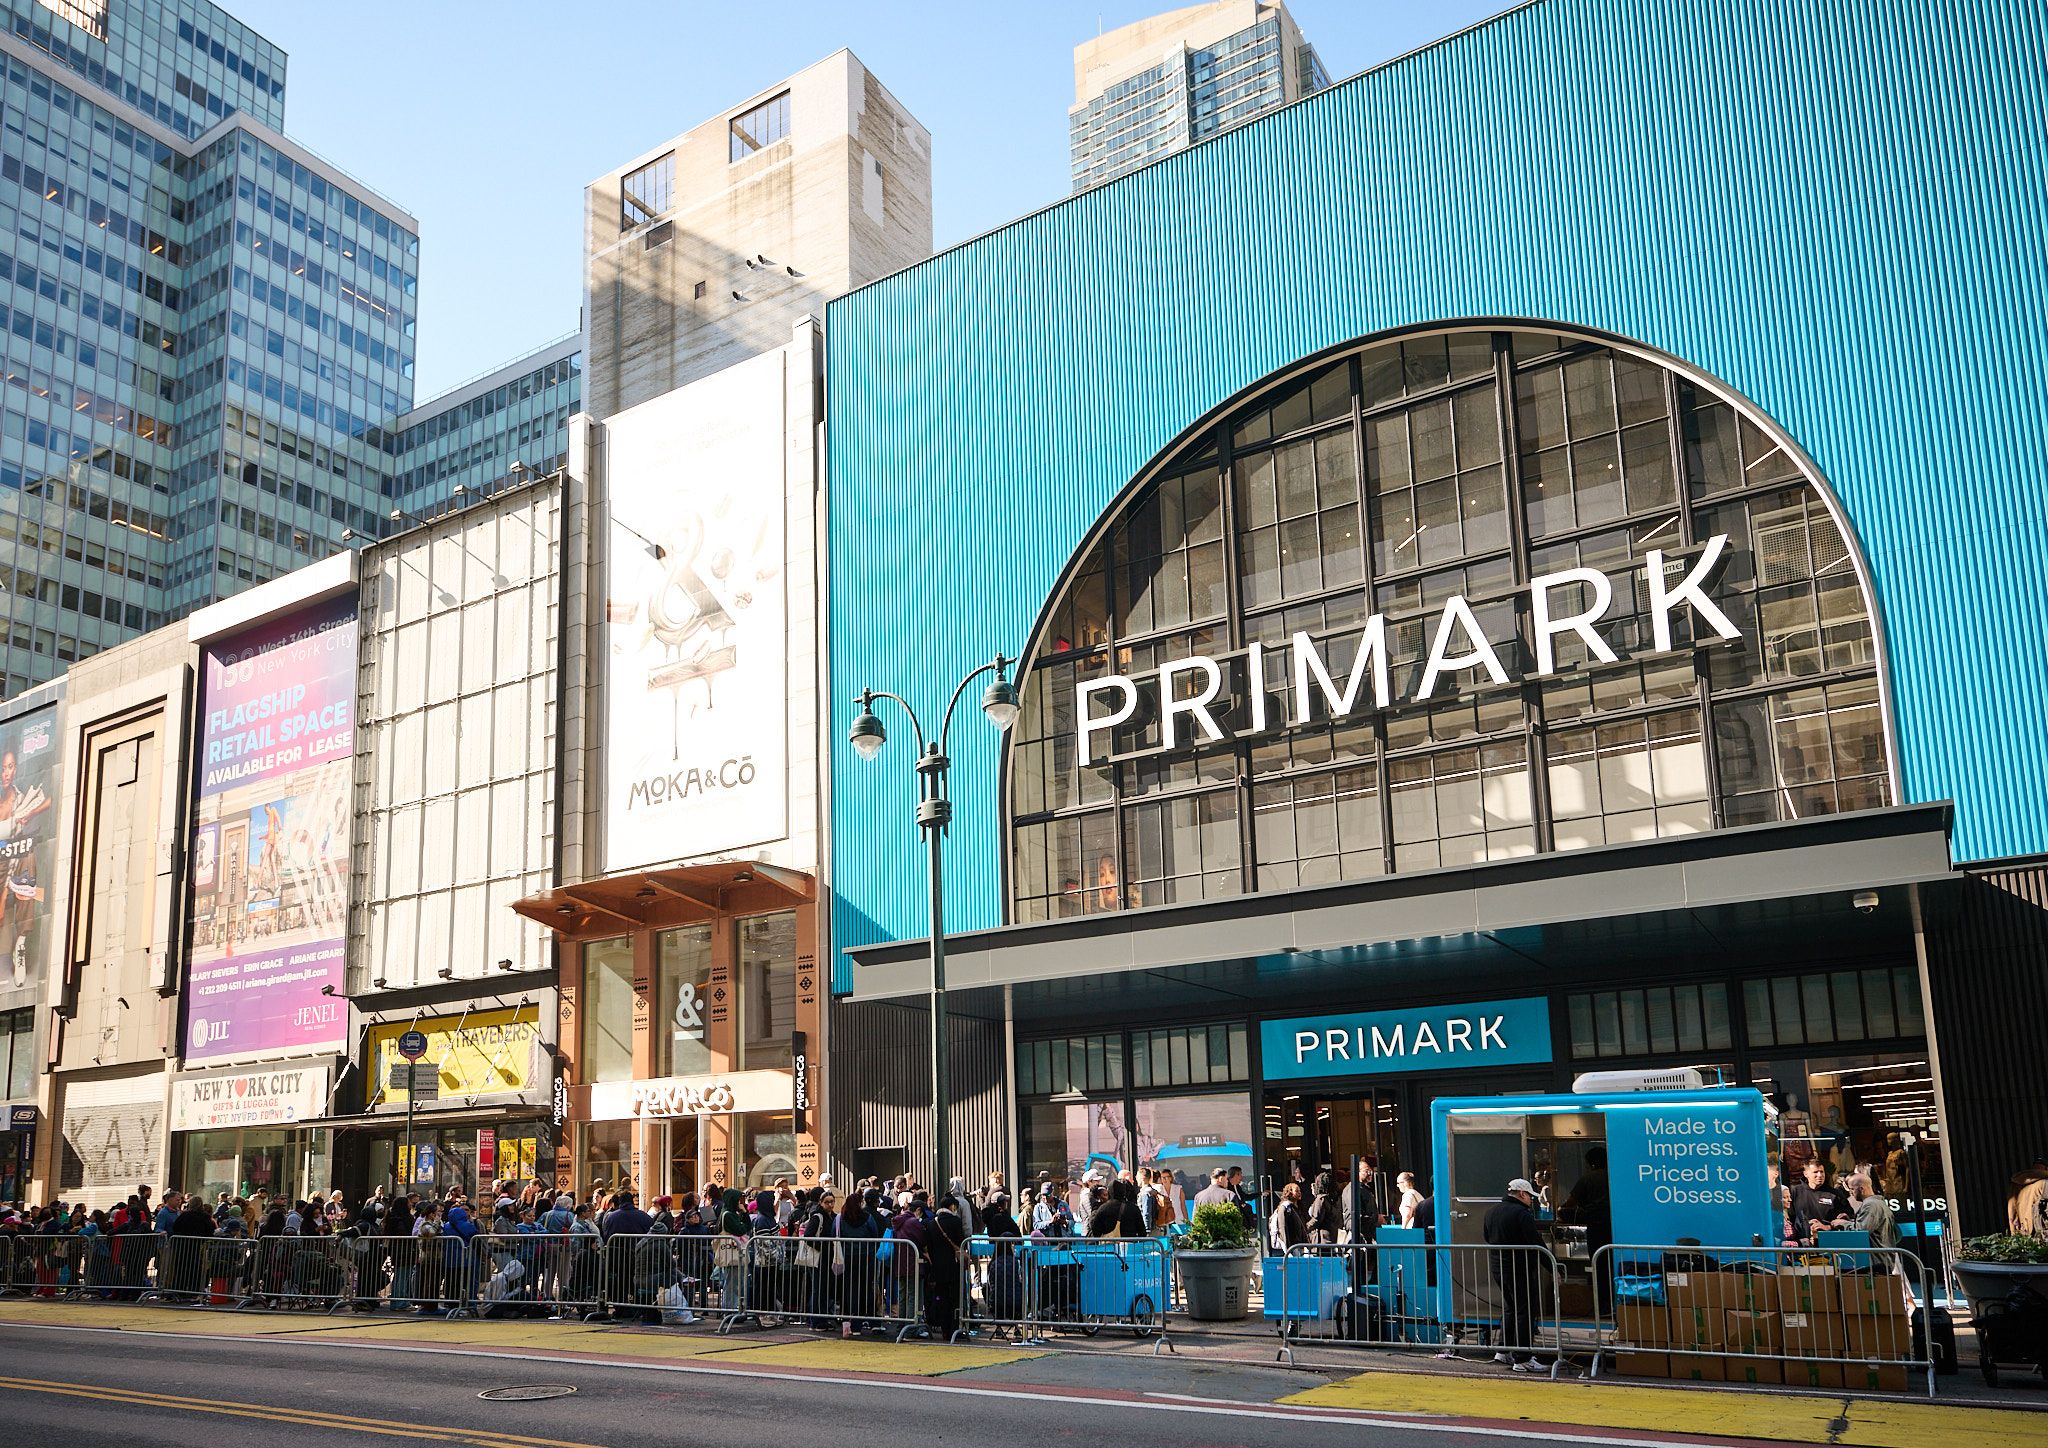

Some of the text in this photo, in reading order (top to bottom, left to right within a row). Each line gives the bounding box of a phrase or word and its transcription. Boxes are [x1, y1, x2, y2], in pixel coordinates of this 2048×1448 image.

[258, 637, 287, 657] West
[318, 612, 355, 633] Street
[257, 632, 355, 676] New York City
[1076, 534, 1742, 766] PRIMARK
[210, 684, 306, 735] FLAGSHIP
[208, 700, 348, 764] RETAIL SPACE
[206, 731, 352, 787] AVAILABLE FOR LEASE
[244, 963, 260, 973] ERIN
[259, 957, 284, 971] GRACE
[289, 952, 317, 966] ARIANE
[316, 947, 345, 961] GIRARD
[294, 1003, 339, 1026] JENEL
[208, 1020, 231, 1042] JLL
[1296, 1015, 1507, 1063] PRIMARK
[194, 1081, 223, 1102] NEW
[271, 1072, 303, 1094] CITY
[213, 1101, 234, 1112] GIFTS
[243, 1098, 279, 1109] LUGGAGE
[1645, 1117, 1736, 1135] Made to
[69, 1115, 159, 1164] KAY
[1195, 1136, 1210, 1145] TAXI
[1648, 1139, 1738, 1160] Impress.
[738, 1163, 746, 1175] A
[1638, 1164, 1740, 1182] Priced to
[1654, 1185, 1742, 1204] Obsess.
[1906, 1197, 1947, 1211] KDS
